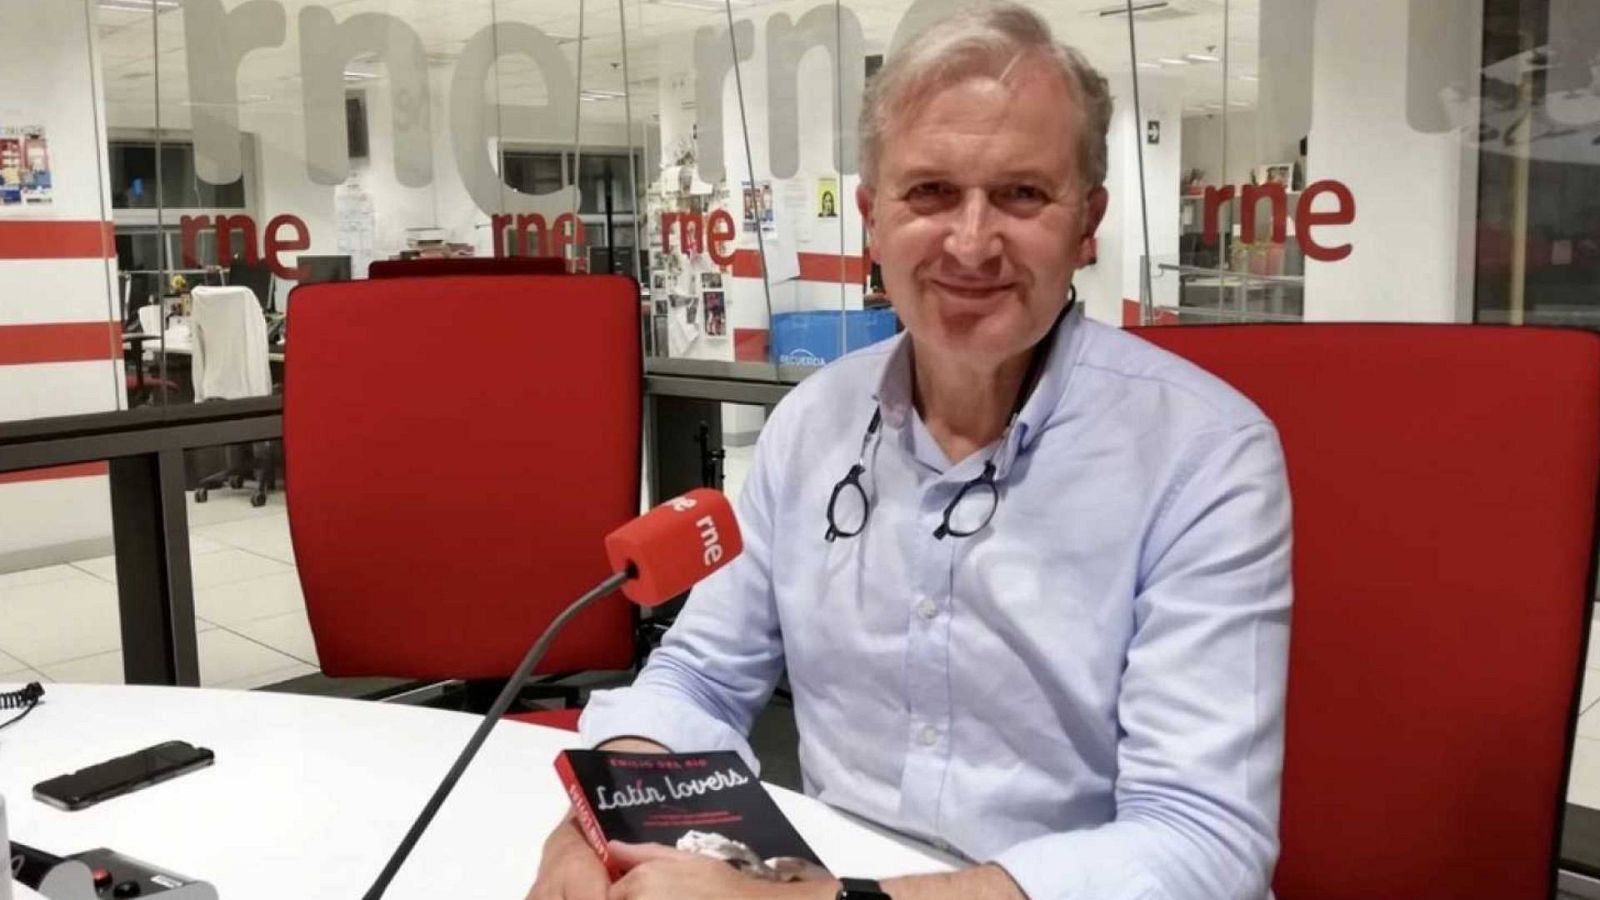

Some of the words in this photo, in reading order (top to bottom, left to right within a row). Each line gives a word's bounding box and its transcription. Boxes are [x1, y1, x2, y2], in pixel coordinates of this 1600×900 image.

[693, 0, 968, 184] rn
[179, 214, 311, 280] rne
[491, 212, 585, 273] rne
[661, 208, 735, 266] rne
[1203, 179, 1356, 262] rne
[695, 515, 722, 567] rne
[664, 768, 749, 799] lovers
